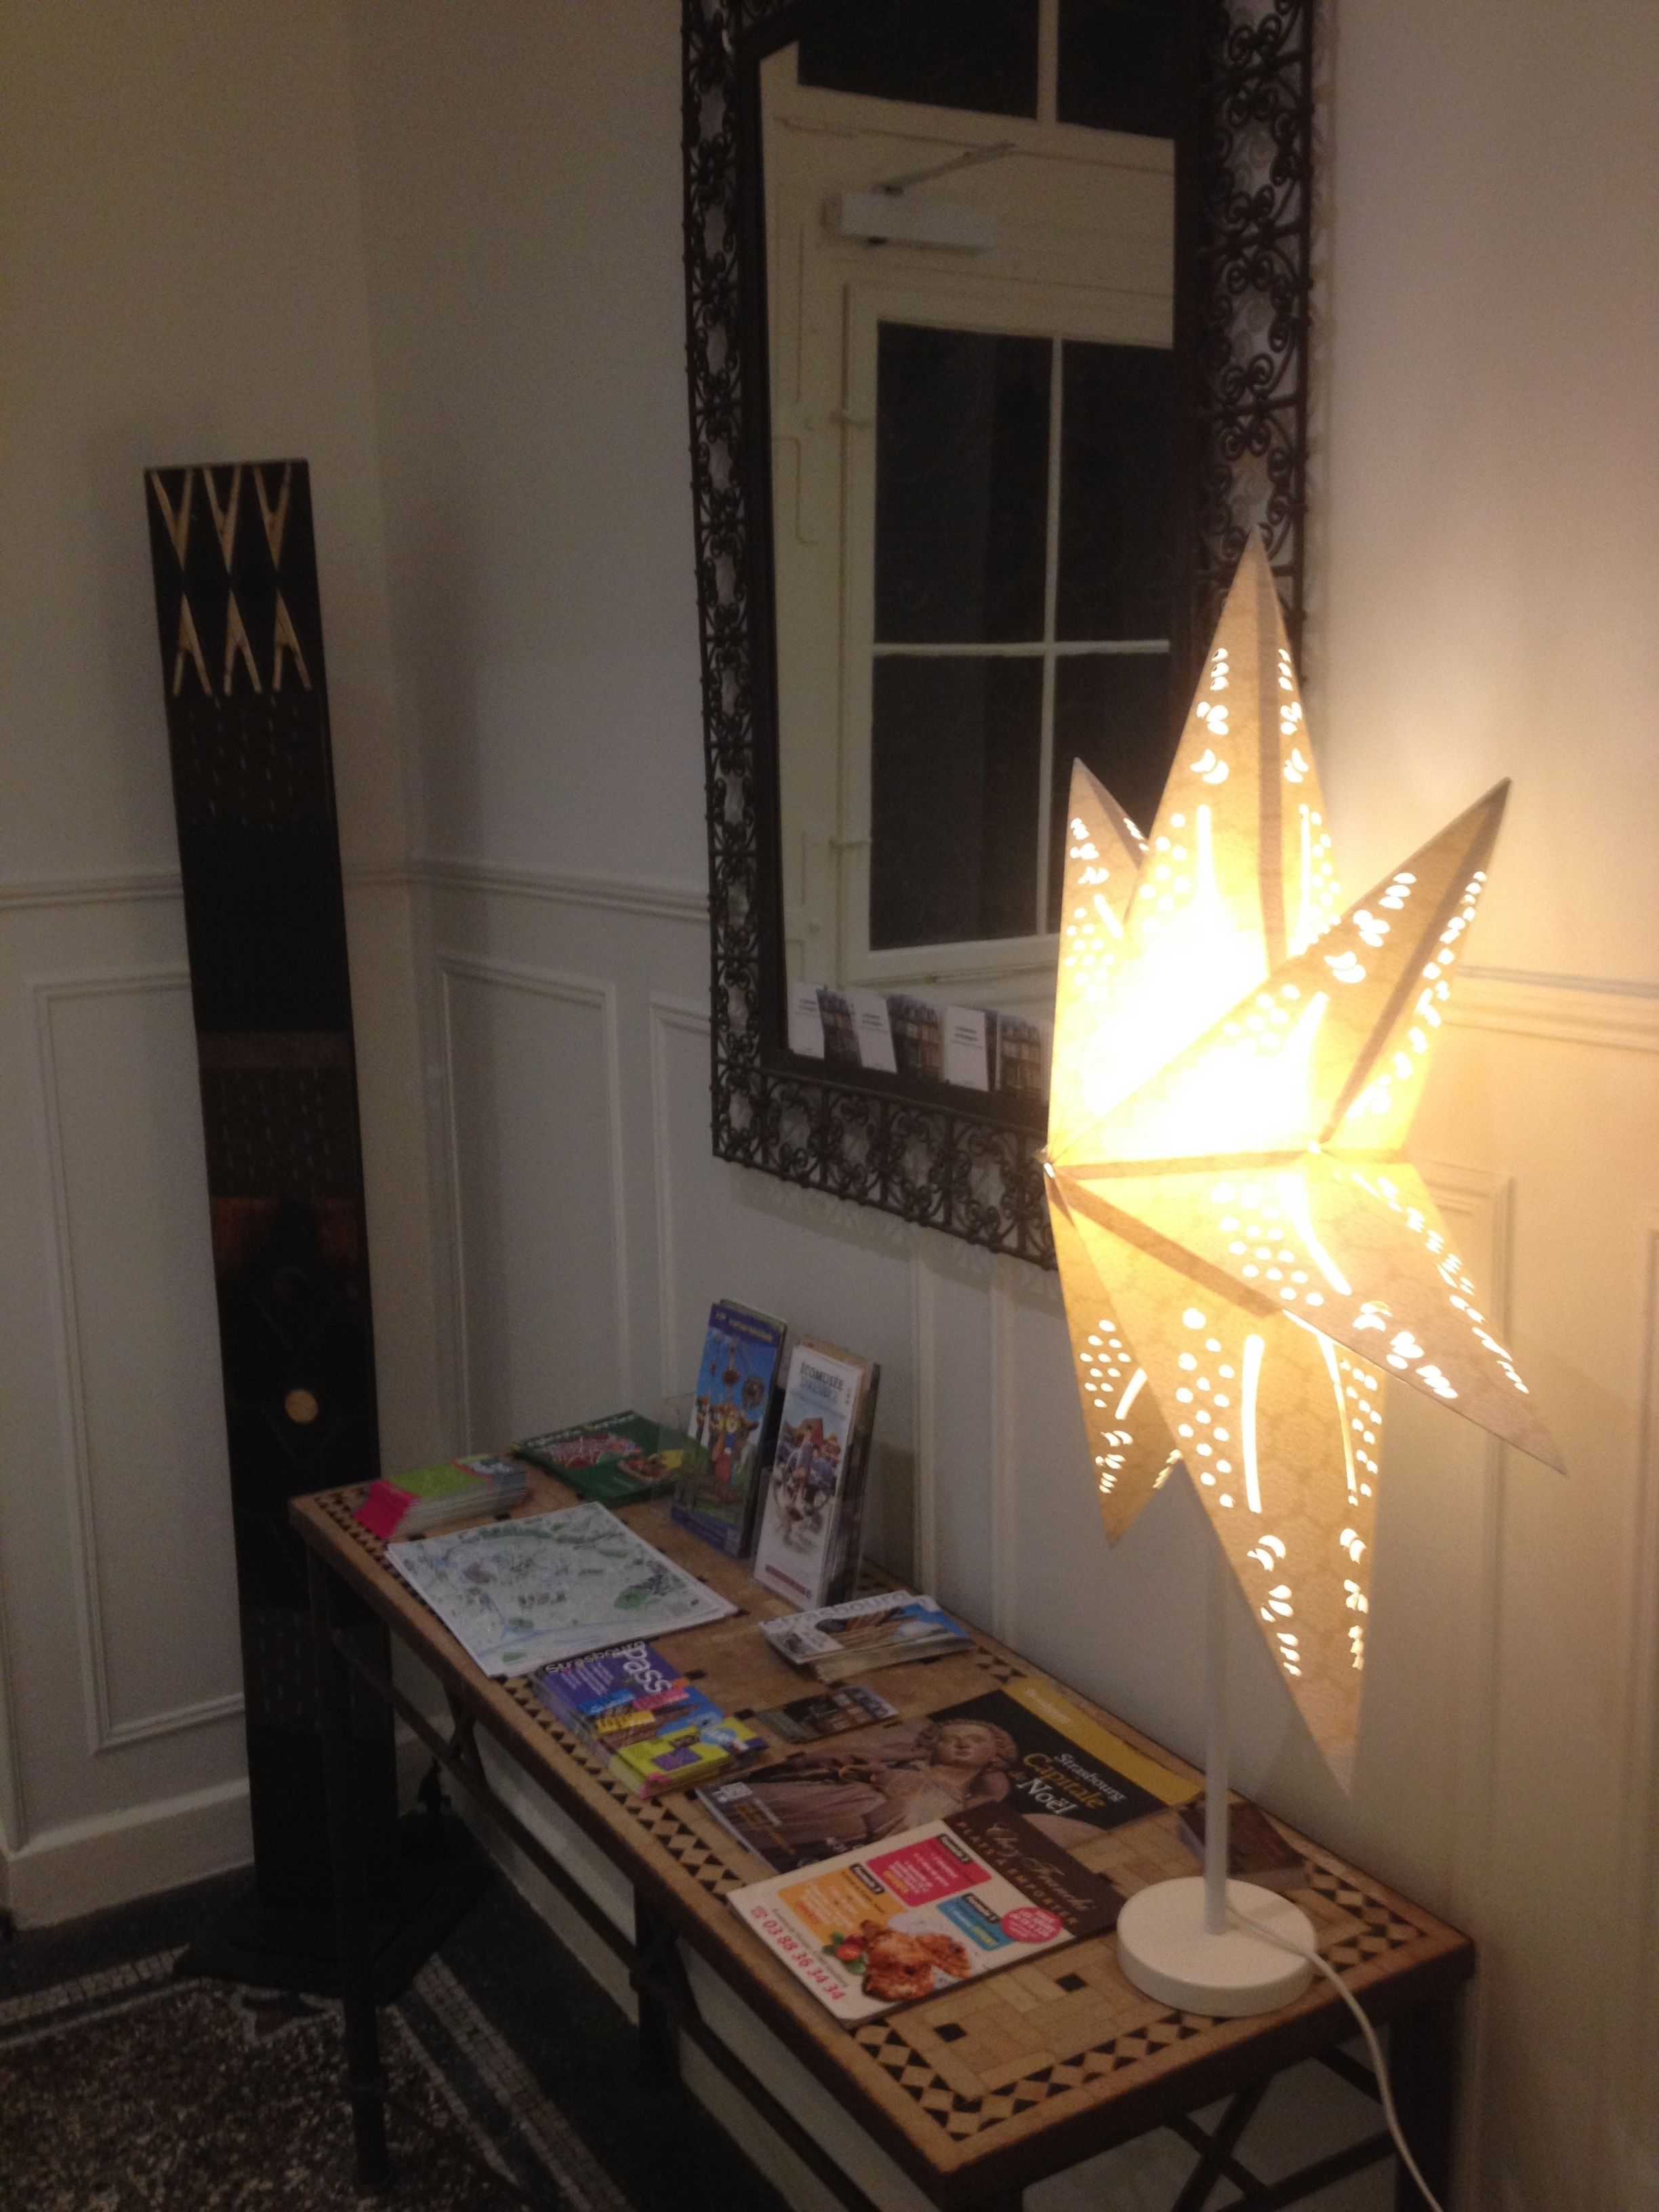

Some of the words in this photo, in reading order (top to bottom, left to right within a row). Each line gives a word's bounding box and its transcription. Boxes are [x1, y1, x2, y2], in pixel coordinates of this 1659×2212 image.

[1016, 1778, 1079, 1815] Noël
[1023, 1753, 1106, 1809] Capitale
[1054, 1753, 1127, 1802] Strasbourg
[956, 1821, 995, 1855] PLATS
[762, 1919, 783, 1935] 03
[777, 1936, 799, 1951] 88
[792, 1951, 814, 1967] 36
[806, 1967, 830, 1983] 34
[821, 1984, 846, 2000] 34
